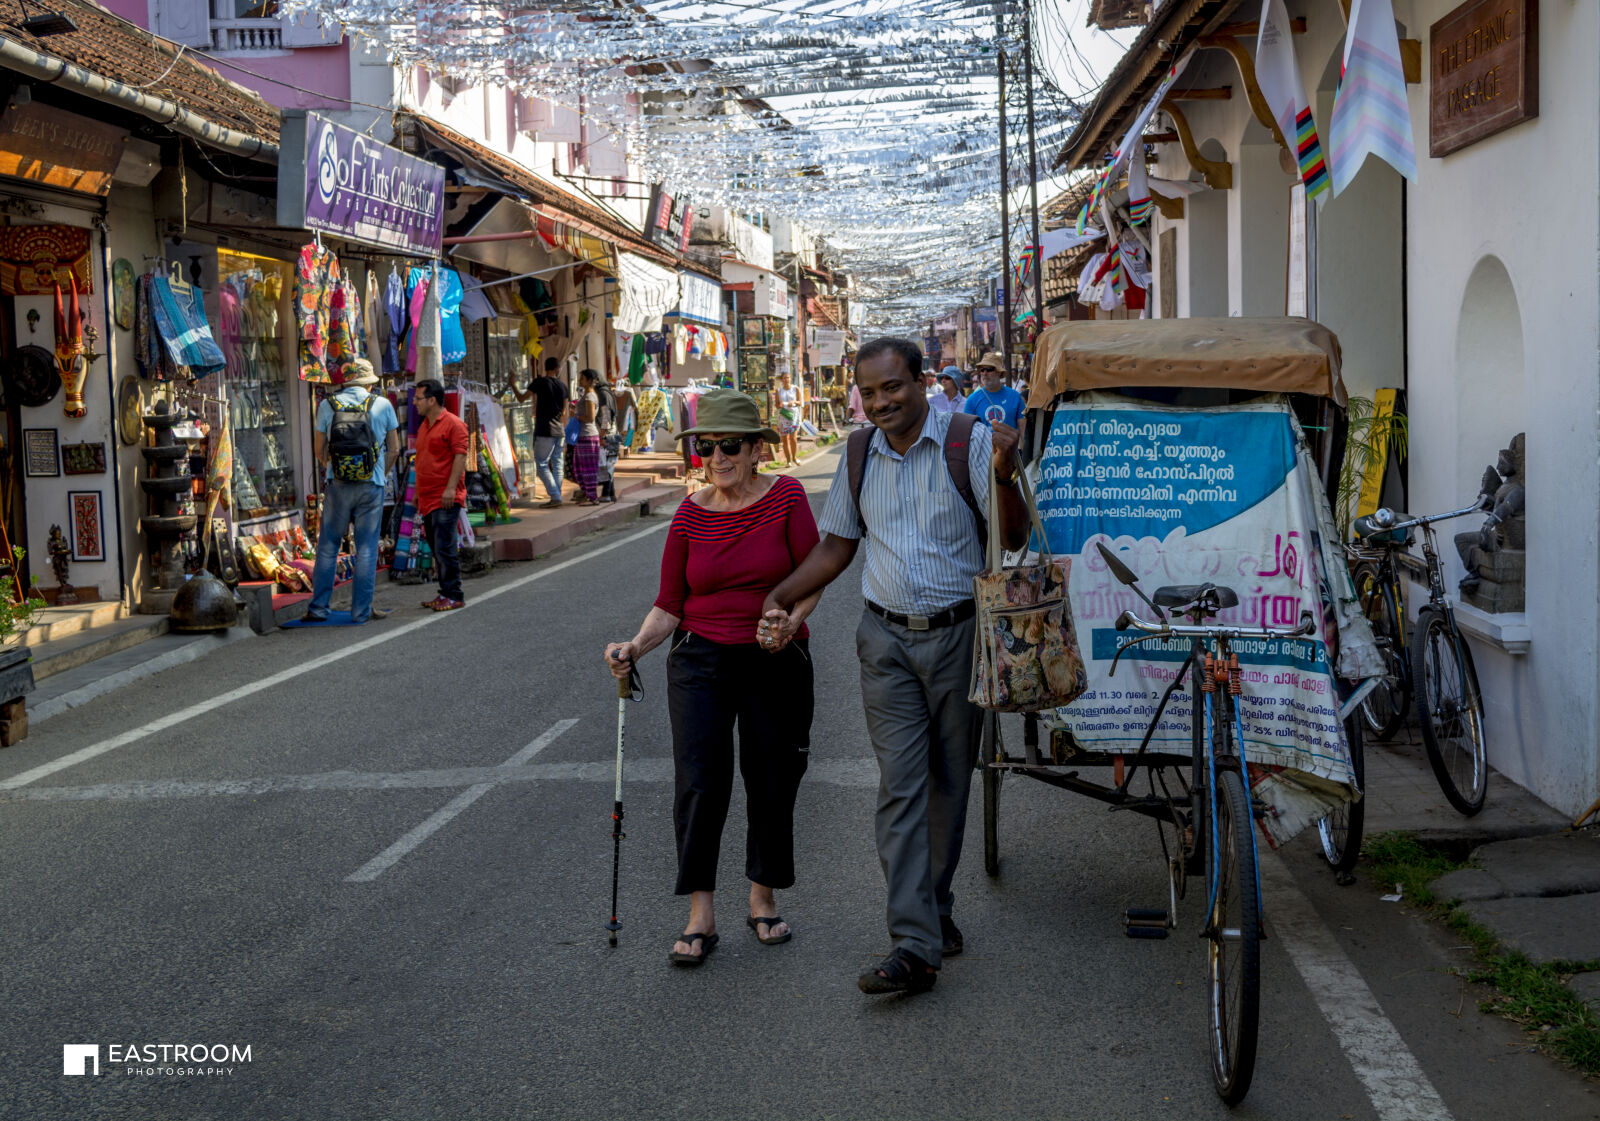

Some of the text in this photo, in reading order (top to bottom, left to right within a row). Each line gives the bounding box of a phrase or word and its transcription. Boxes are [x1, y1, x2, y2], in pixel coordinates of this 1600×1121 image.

[1440, 9, 1512, 76] THE ETHNIC
[1448, 65, 1501, 118] PASSAGE
[63, 128, 113, 156] EXPORTS
[391, 167, 436, 214] Collection
[336, 191, 378, 216] Pride
[401, 210, 435, 232] India
[1099, 418, 1182, 440] തിരുഹൃദയ
[1177, 485, 1237, 504] എന്നിവ
[1099, 691, 1122, 700] 11.30
[1254, 726, 1272, 736] 25%
